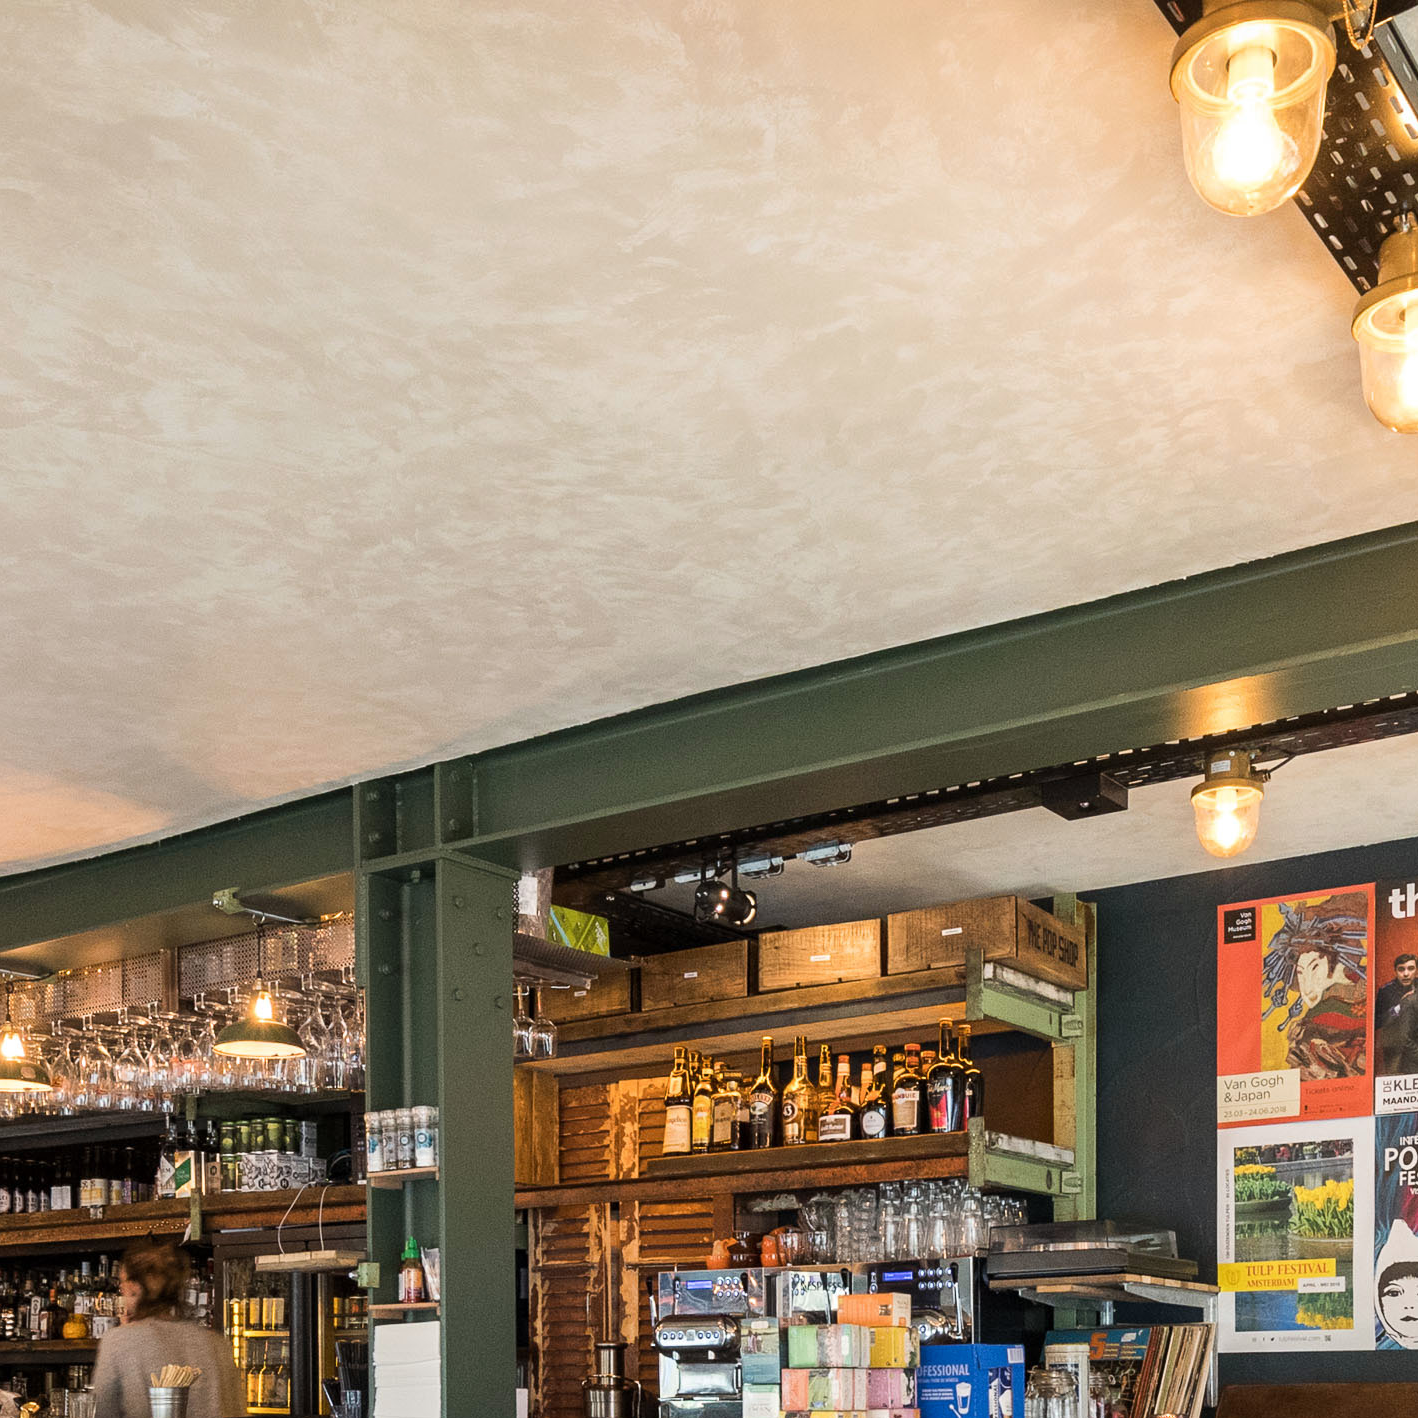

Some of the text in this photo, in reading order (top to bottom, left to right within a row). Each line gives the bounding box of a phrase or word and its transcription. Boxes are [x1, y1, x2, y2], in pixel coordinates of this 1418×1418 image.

[1042, 927, 1057, 958] POP
[1059, 935, 1079, 968] SHOP
[1224, 1075, 1284, 1091] Van Gogh
[1224, 1089, 1270, 1103] & Japan
[1246, 1263, 1330, 1277] TULP FESTIVAL
[1246, 1278, 1295, 1288] AMSTERDAM
[1090, 1332, 1107, 1360] 5
